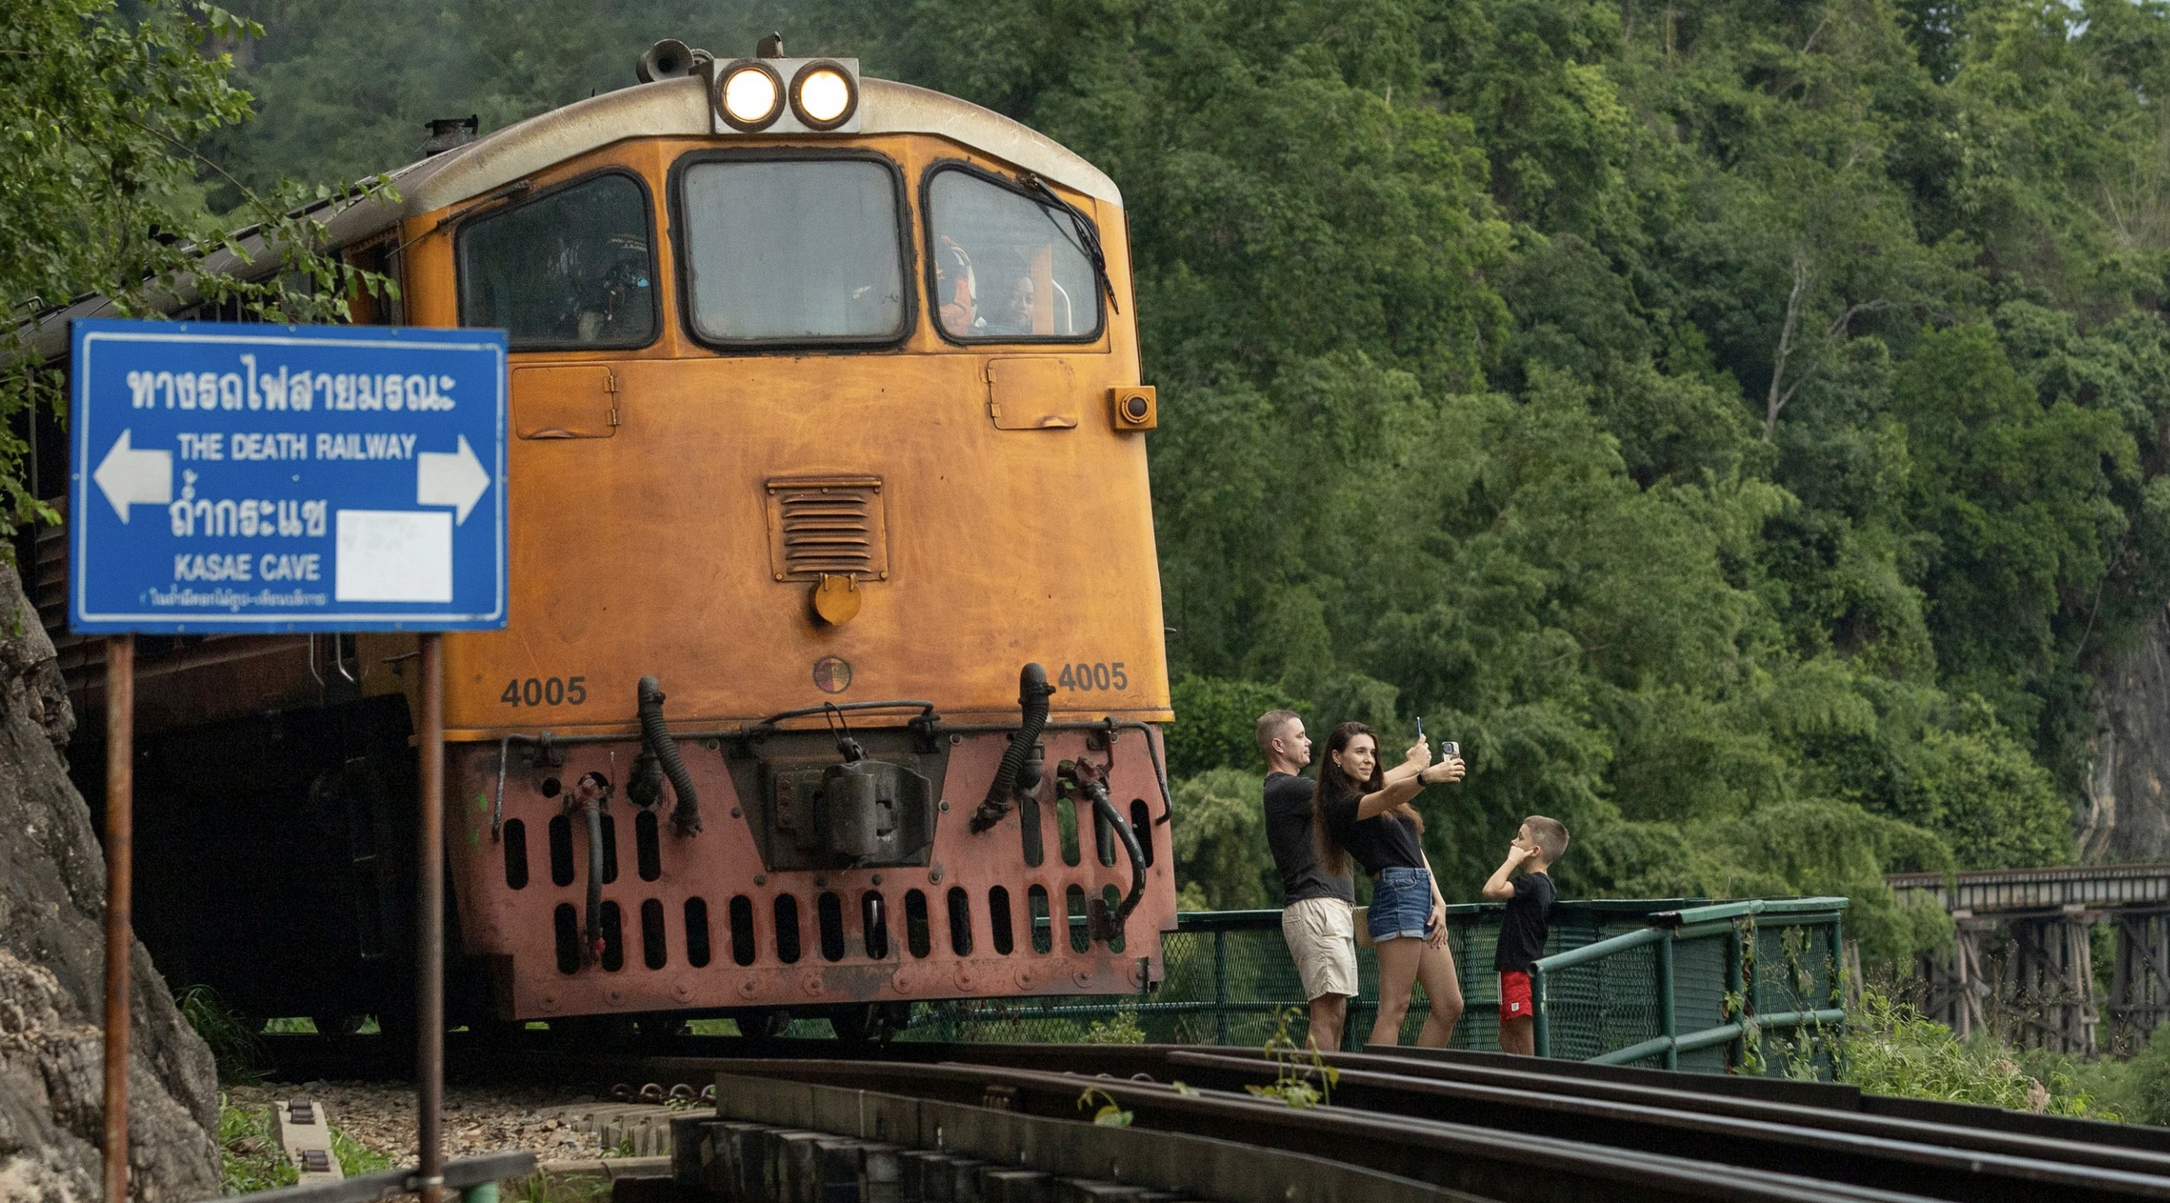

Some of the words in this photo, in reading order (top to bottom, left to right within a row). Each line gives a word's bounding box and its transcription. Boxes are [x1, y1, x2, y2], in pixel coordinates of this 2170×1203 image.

[126, 353, 456, 412] ทางรถไฟสายมรณะ
[177, 433, 224, 460] THE
[231, 433, 308, 460] DEATH
[316, 433, 417, 460] RAILWAY
[174, 553, 252, 581] KASAE
[259, 553, 320, 581] CAVE
[500, 676, 587, 708] 4005
[1058, 662, 1128, 692] 4005
